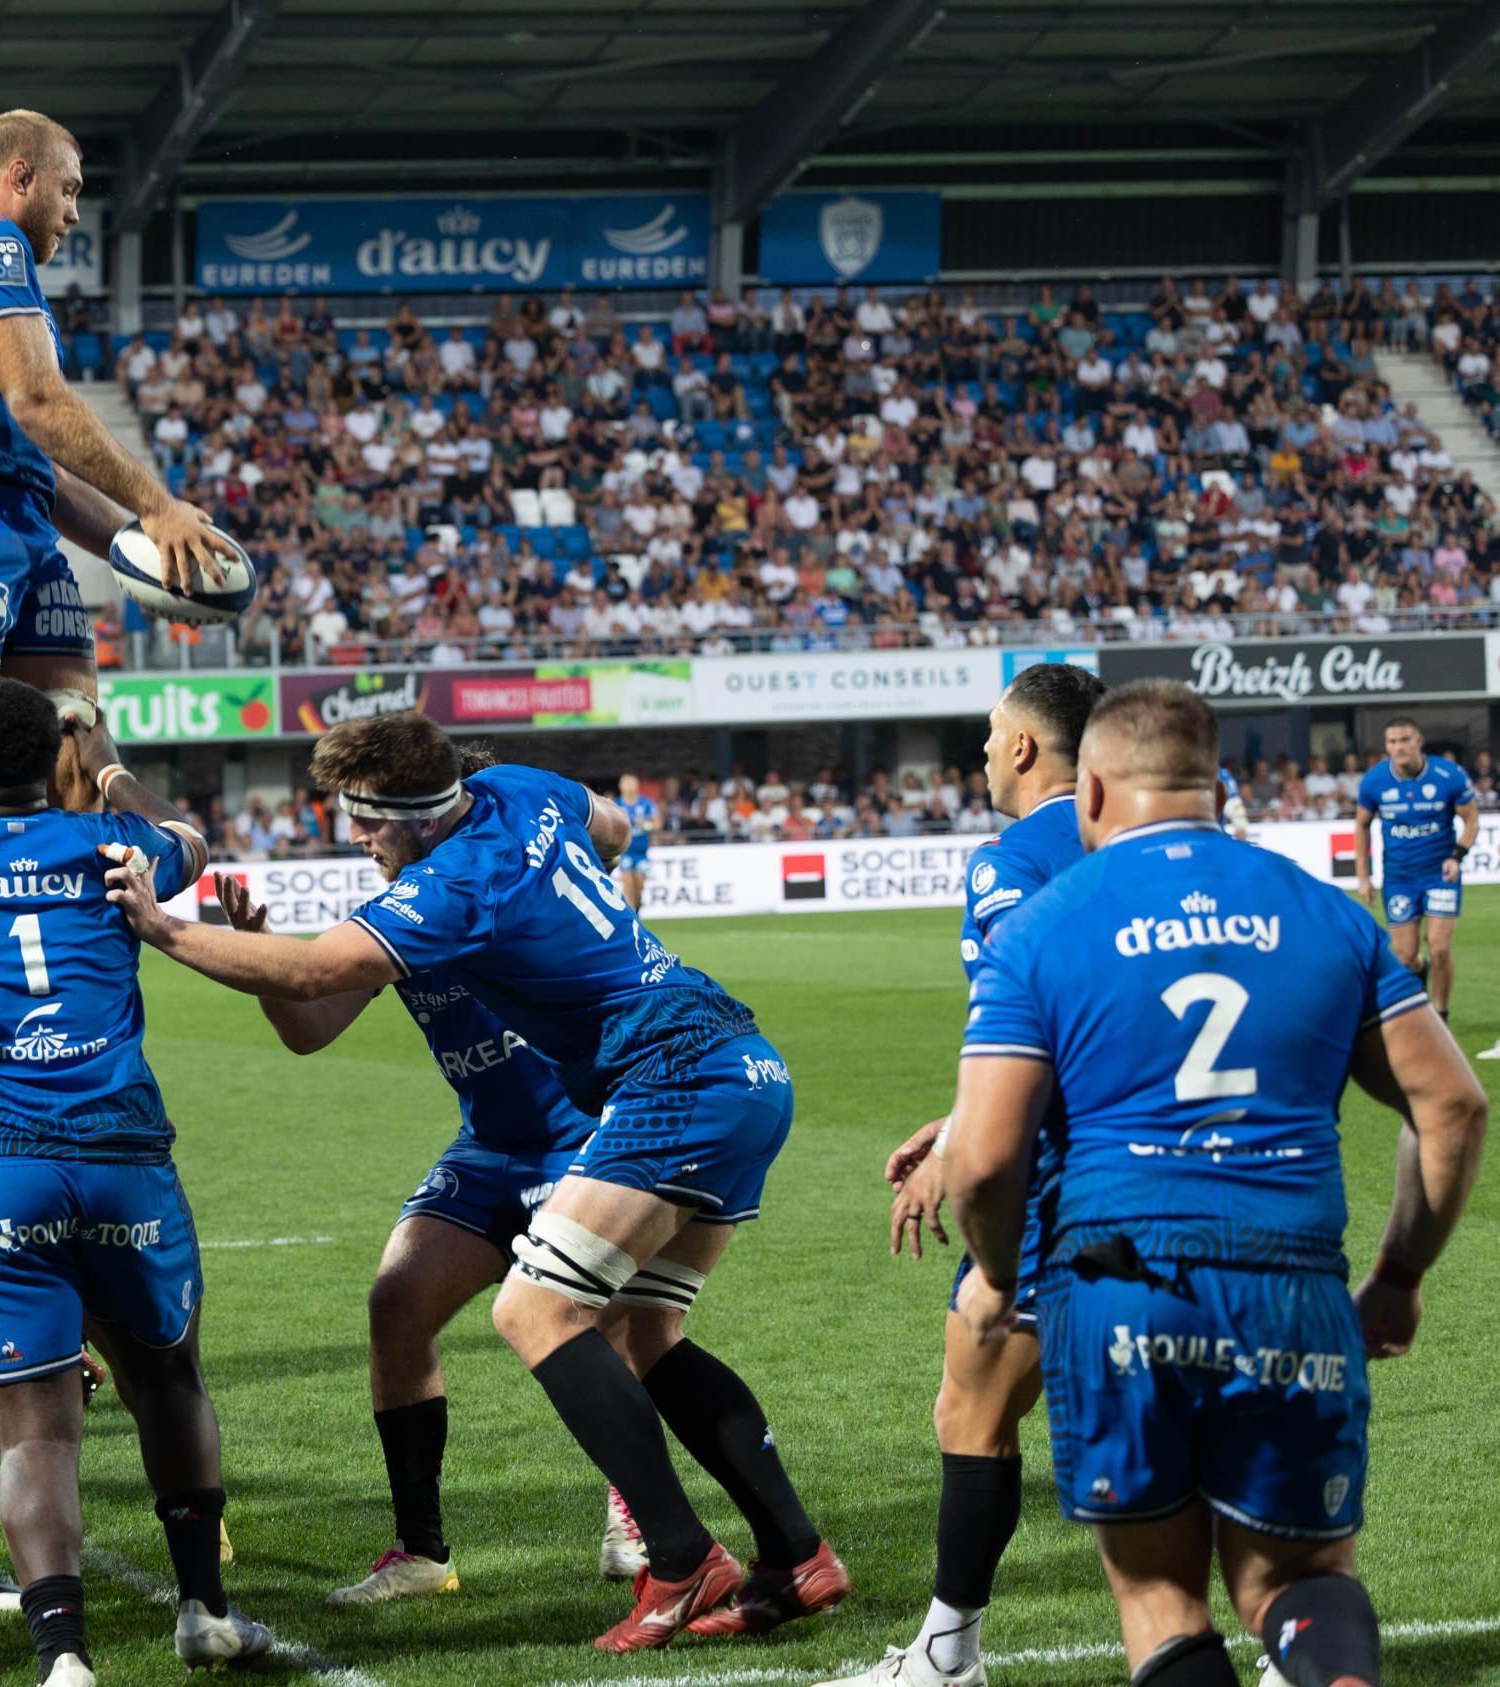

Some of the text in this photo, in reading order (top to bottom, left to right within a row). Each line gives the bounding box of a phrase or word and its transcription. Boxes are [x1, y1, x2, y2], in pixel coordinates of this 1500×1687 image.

[202, 264, 331, 287] EUREDEN
[356, 229, 551, 284] d'aucy
[581, 256, 707, 280] EUREDEN
[35, 608, 93, 640] CONSE
[725, 664, 971, 694] OUEST CONSEILS
[1186, 642, 1404, 702] Breizh Cola
[266, 866, 377, 895] SOCIE
[551, 841, 627, 942] 18
[8, 913, 50, 995] 1
[1115, 915, 1280, 957] d'aucy
[1161, 972, 1257, 1102] 2
[98, 1219, 162, 1252] TOQUE
[1257, 1347, 1348, 1393] TOQUE
